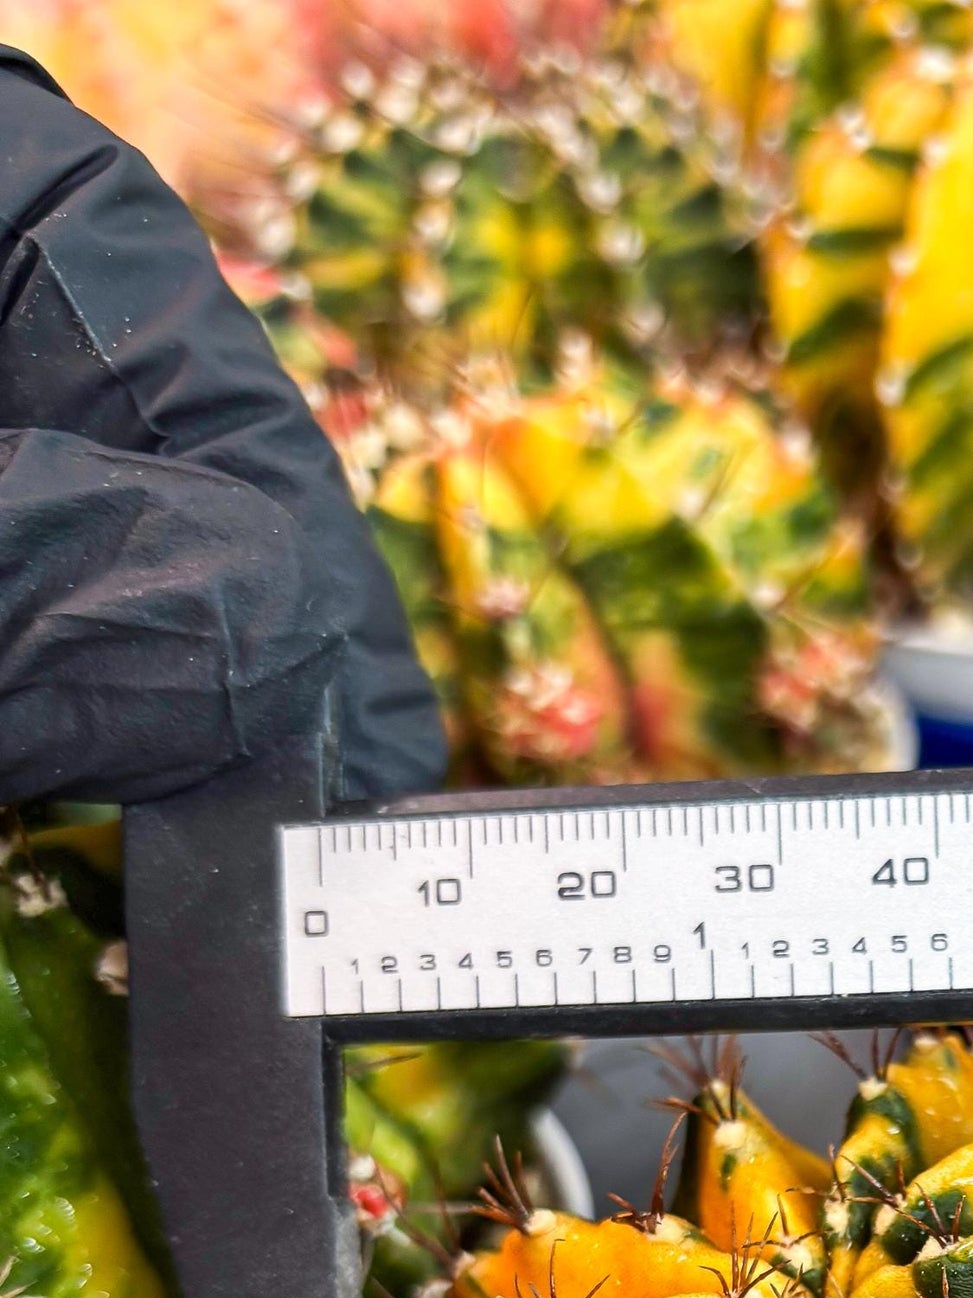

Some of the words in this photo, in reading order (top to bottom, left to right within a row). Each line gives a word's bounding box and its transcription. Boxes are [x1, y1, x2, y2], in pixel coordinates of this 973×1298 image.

[416, 878, 462, 907] 10
[557, 871, 617, 901] 20
[715, 863, 775, 893] 30
[871, 857, 930, 888] 40
[303, 909, 329, 938] 0
[350, 958, 360, 975] 1
[381, 955, 398, 973] 2
[419, 953, 437, 971] 3
[457, 952, 474, 970] 4
[495, 950, 513, 968] 5
[535, 948, 553, 967] 6
[577, 947, 594, 965] 7
[613, 945, 633, 964] 8
[653, 944, 673, 964] 9
[692, 921, 706, 950] 1
[740, 942, 750, 959] 1
[771, 939, 790, 958] 2
[811, 937, 830, 956] 3
[851, 936, 868, 955] 4
[890, 934, 908, 953] 5
[930, 932, 949, 952] 6
